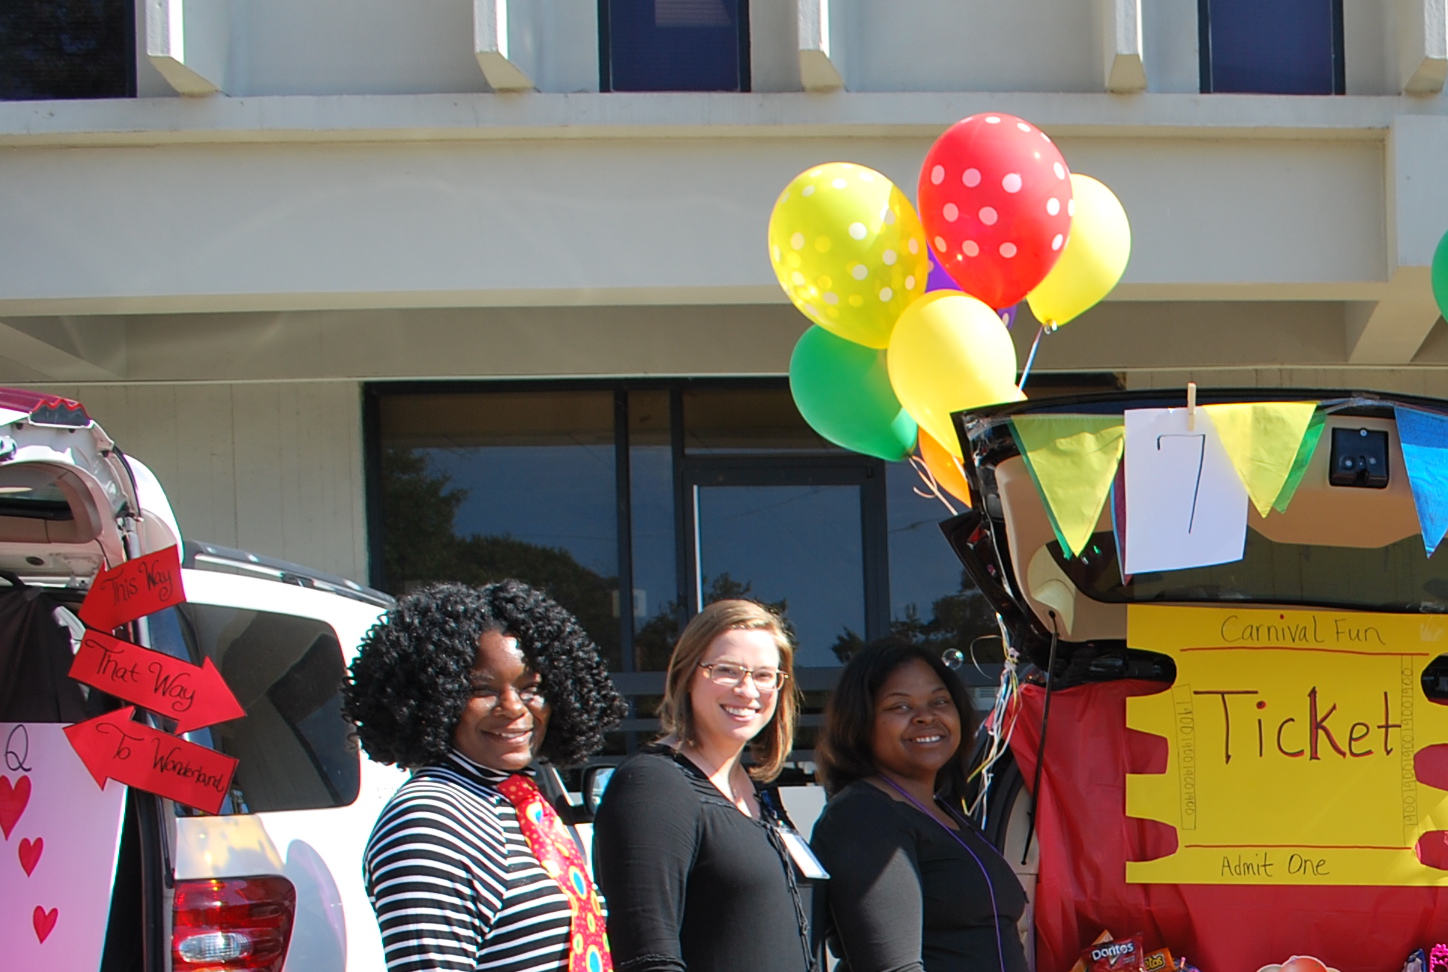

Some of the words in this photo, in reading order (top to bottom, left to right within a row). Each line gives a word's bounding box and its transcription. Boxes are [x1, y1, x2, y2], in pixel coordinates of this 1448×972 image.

[1156, 432, 1206, 535] 7
[101, 568, 138, 606] This
[138, 560, 173, 602] Way
[1220, 614, 1325, 644] Carnival
[1334, 617, 1386, 645] Fun
[85, 639, 140, 683] That
[148, 662, 196, 712] Way
[5, 723, 32, 772] Q
[1193, 686, 1402, 765] Ticket
[96, 722, 144, 760] To
[151, 737, 225, 793] Wonderland
[1221, 852, 1274, 877] Admit
[1288, 853, 1330, 877] One
[1091, 942, 1135, 961] Doritos
